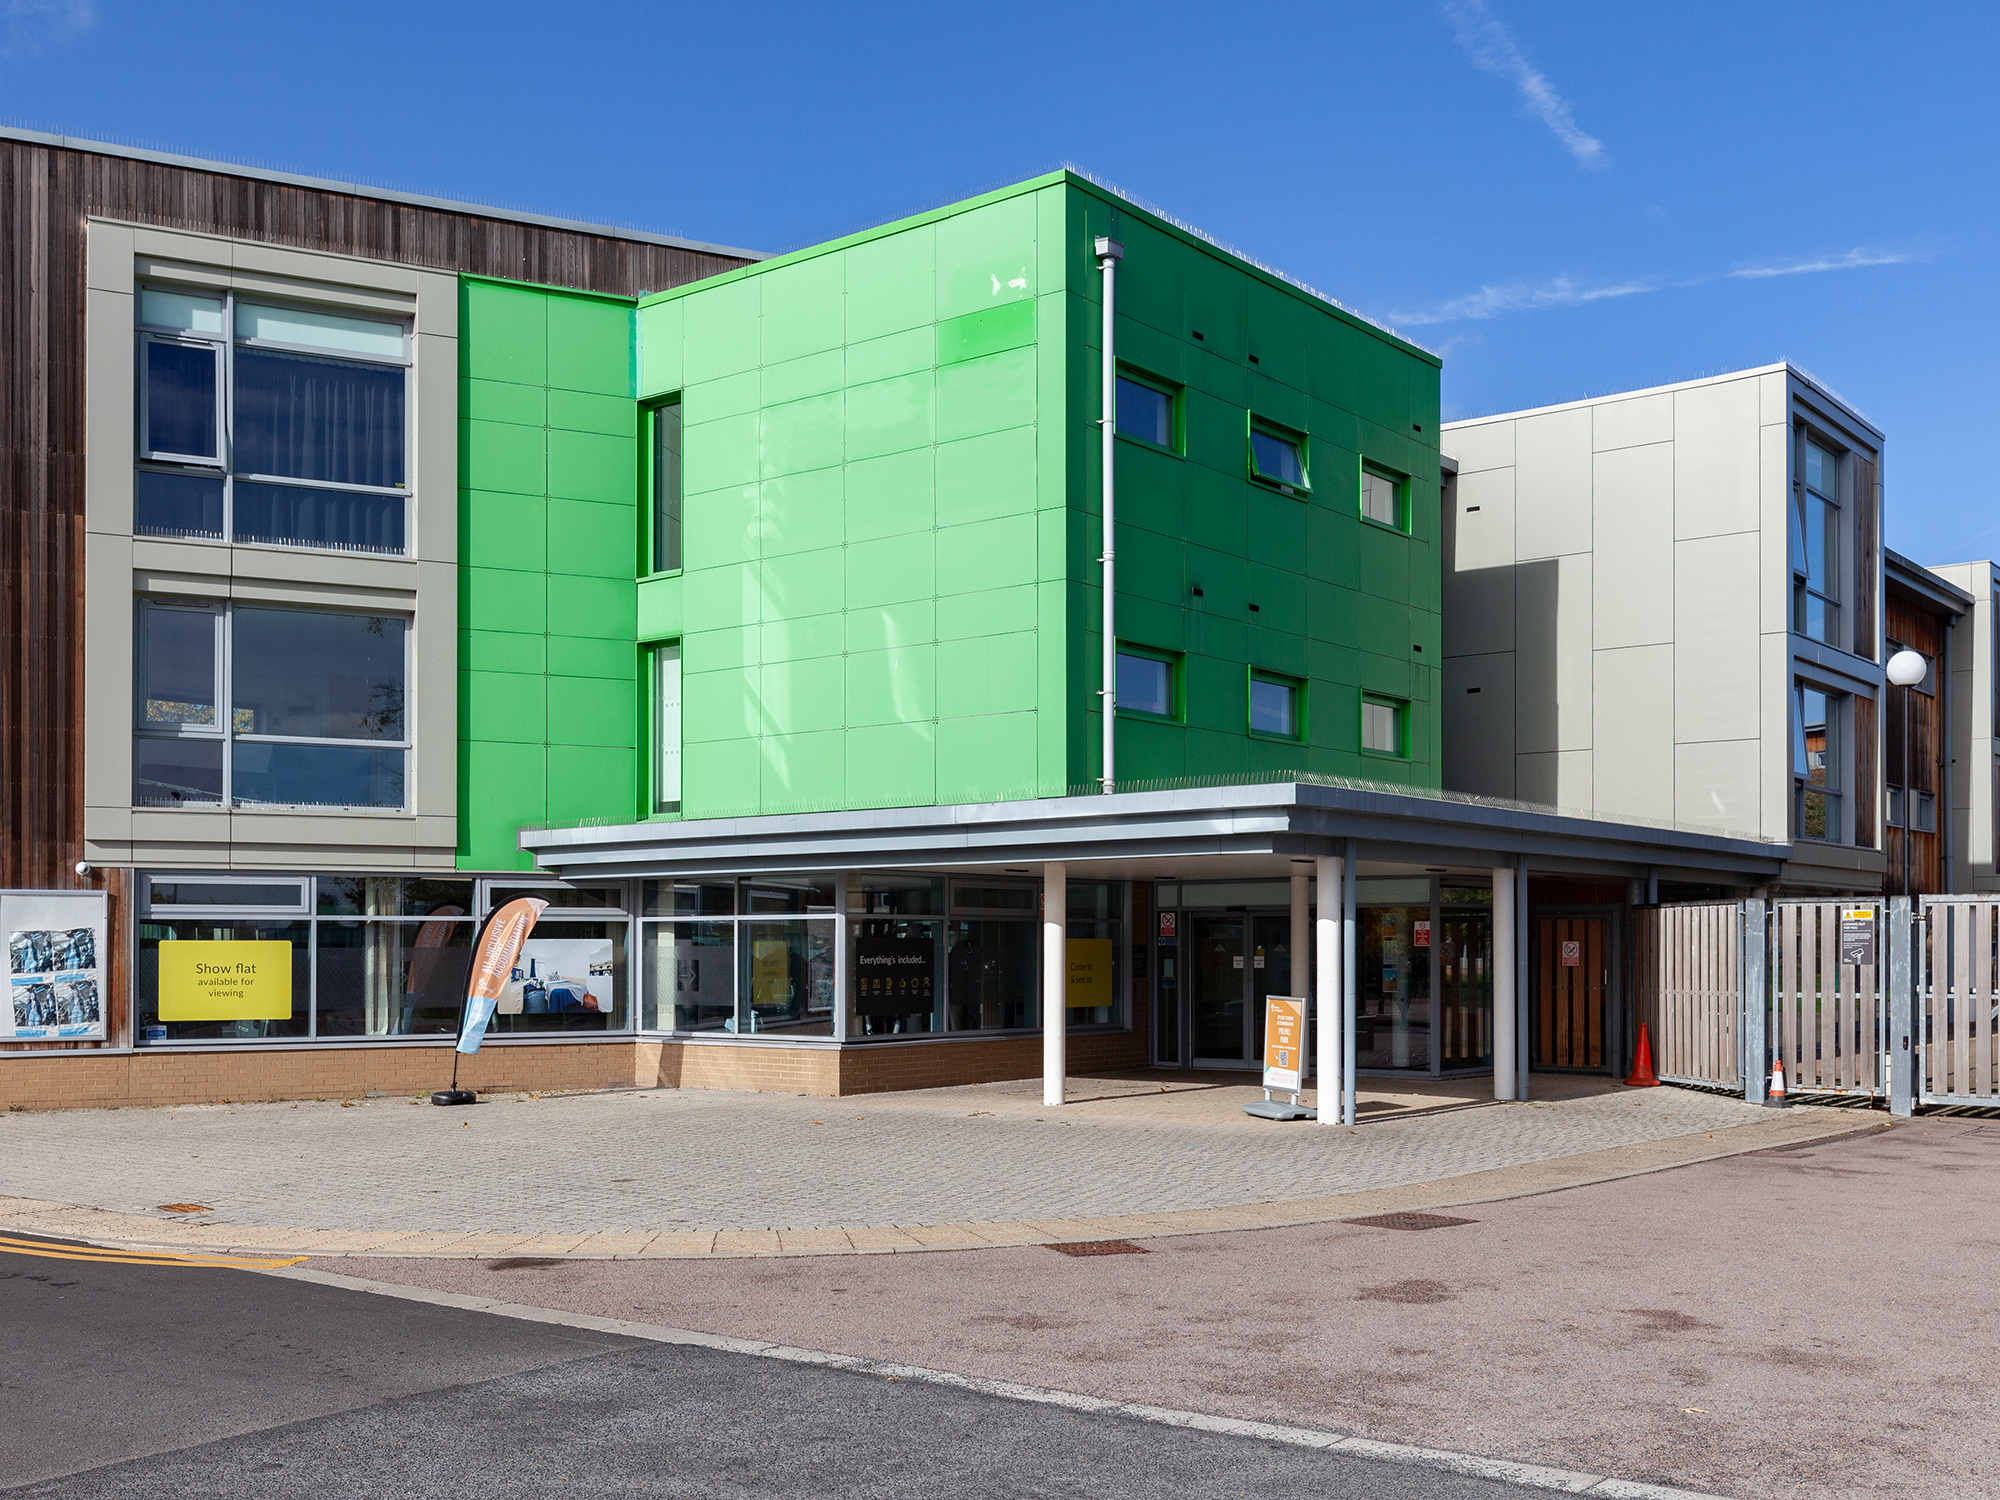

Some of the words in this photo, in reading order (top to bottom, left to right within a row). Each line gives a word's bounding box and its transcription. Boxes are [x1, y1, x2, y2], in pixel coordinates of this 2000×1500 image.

[492, 914, 529, 979] ACCOMMODATION
[860, 955, 896, 966] Everything's
[897, 955, 926, 964] included...
[196, 963, 232, 974] Show
[236, 962, 256, 974] flat
[1070, 962, 1087, 971] Come
[1087, 962, 1093, 971] in
[197, 977, 239, 986] available
[241, 977, 254, 986] for
[1070, 974, 1075, 984] &
[1076, 976, 1085, 984] see
[1086, 976, 1093, 984] us
[208, 988, 244, 998] viewing
[1279, 1036, 1289, 1044] PARK
